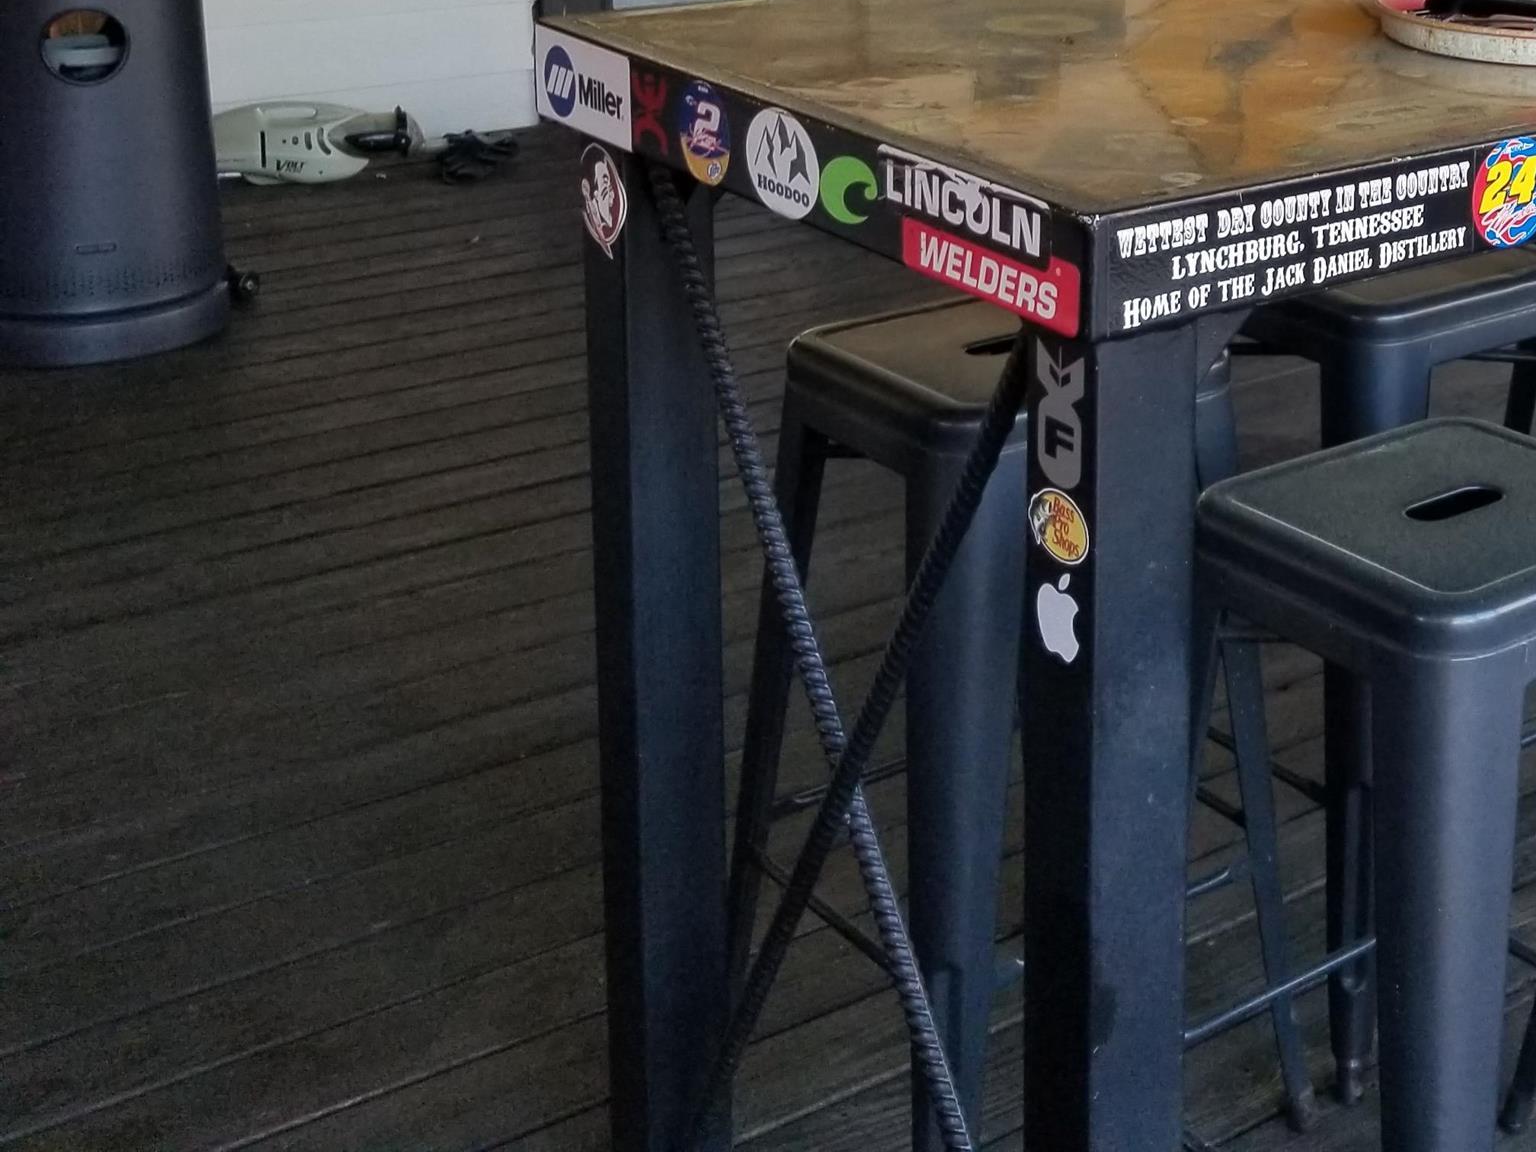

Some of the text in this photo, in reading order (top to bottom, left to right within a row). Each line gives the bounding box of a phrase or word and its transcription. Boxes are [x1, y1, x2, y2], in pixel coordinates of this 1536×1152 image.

[578, 73, 623, 120] Miller
[693, 101, 720, 139] 2
[756, 172, 810, 209] HOODOO
[884, 157, 1041, 258] LINCOLN
[1117, 161, 1470, 259] WETTEST DRY COUNTY IN THE COUNTRY
[1171, 203, 1425, 280] LYNCHBURG, TENNESSEE
[919, 231, 1059, 321] WELDERS
[1122, 226, 1467, 329] HOME OF THE JACK DANIEL DISTILLERY
[1053, 496, 1075, 523] Bass
[1052, 530, 1080, 557] Shops
